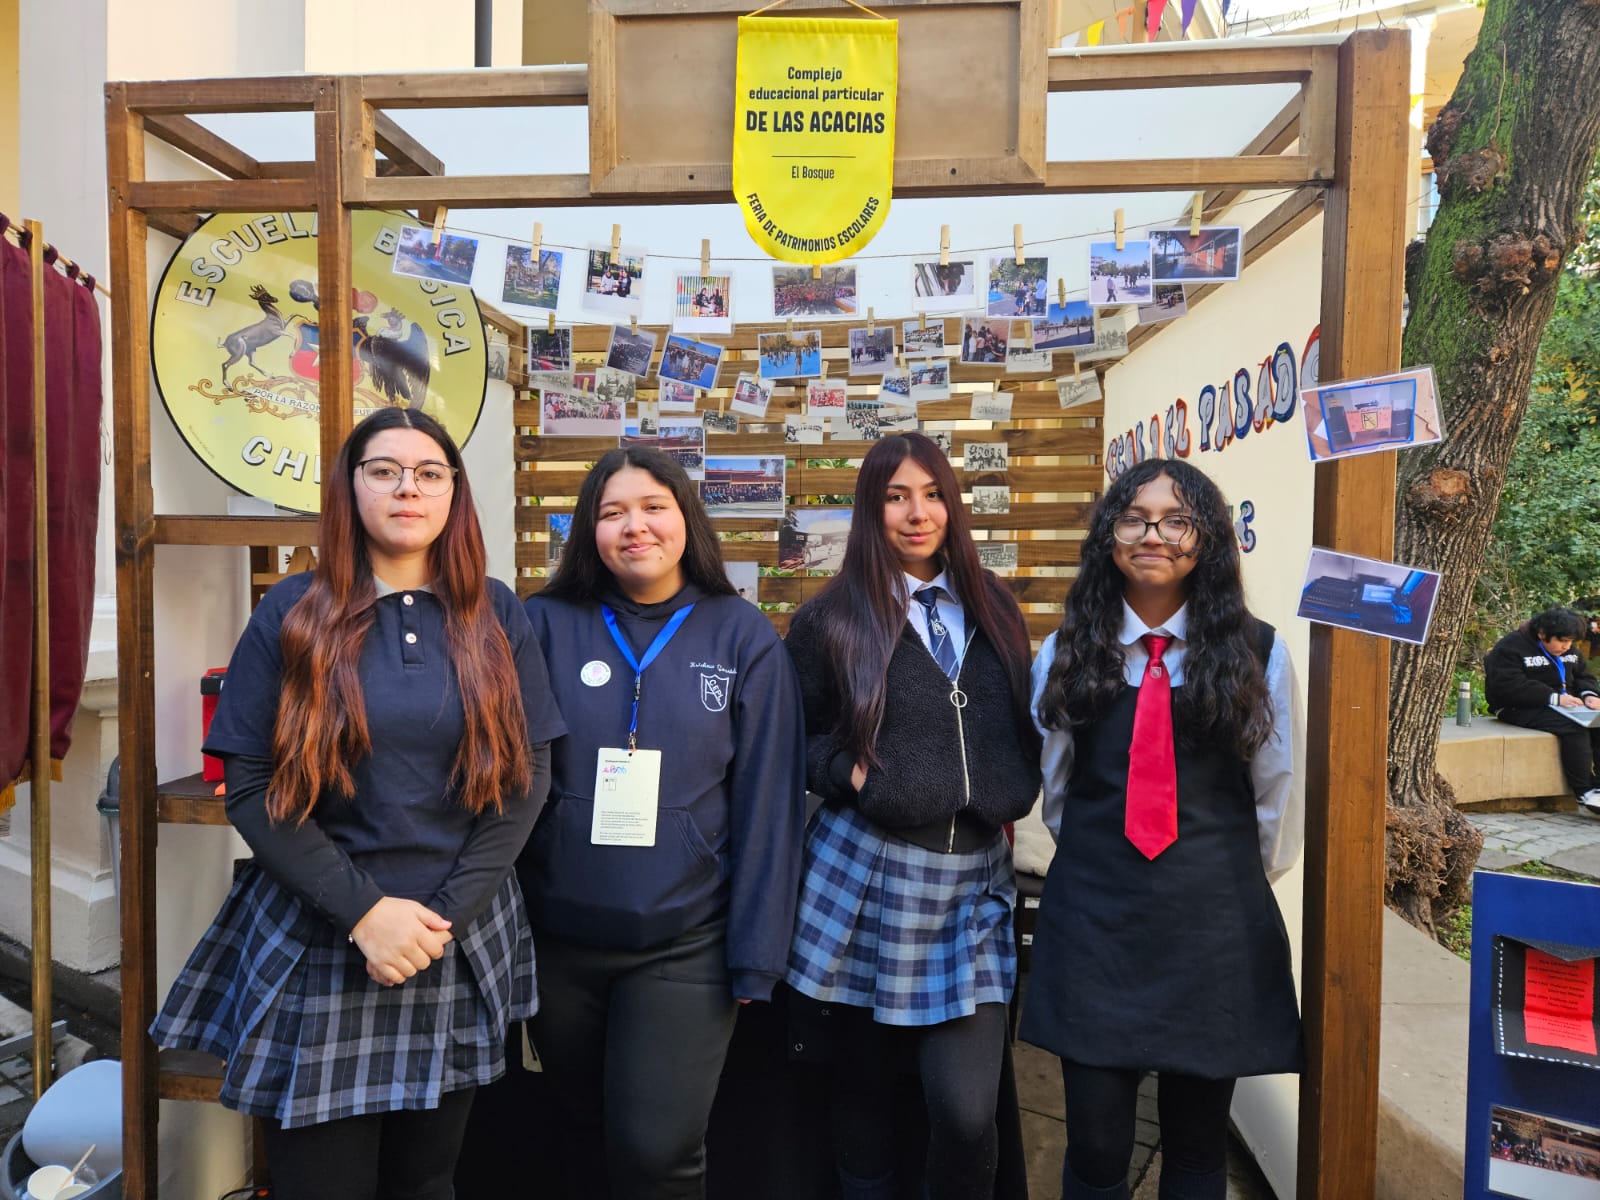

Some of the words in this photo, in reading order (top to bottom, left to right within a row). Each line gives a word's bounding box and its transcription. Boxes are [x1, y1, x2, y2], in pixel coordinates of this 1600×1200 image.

[788, 66, 842, 82] Complejo
[749, 86, 819, 100] educacional
[822, 87, 884, 102] particular
[746, 110, 767, 132] DE
[773, 110, 804, 132] LAS
[810, 110, 885, 133] ACACIAS
[791, 165, 799, 178] El
[802, 165, 834, 180] Bosque
[747, 193, 767, 222] FERIA
[762, 219, 777, 236] DE
[774, 229, 837, 252] PATRIMONIOS
[837, 196, 880, 246] ESCOLARES
[254, 388, 273, 400] POR
[275, 395, 286, 404] LA
[242, 436, 320, 485] CHI
